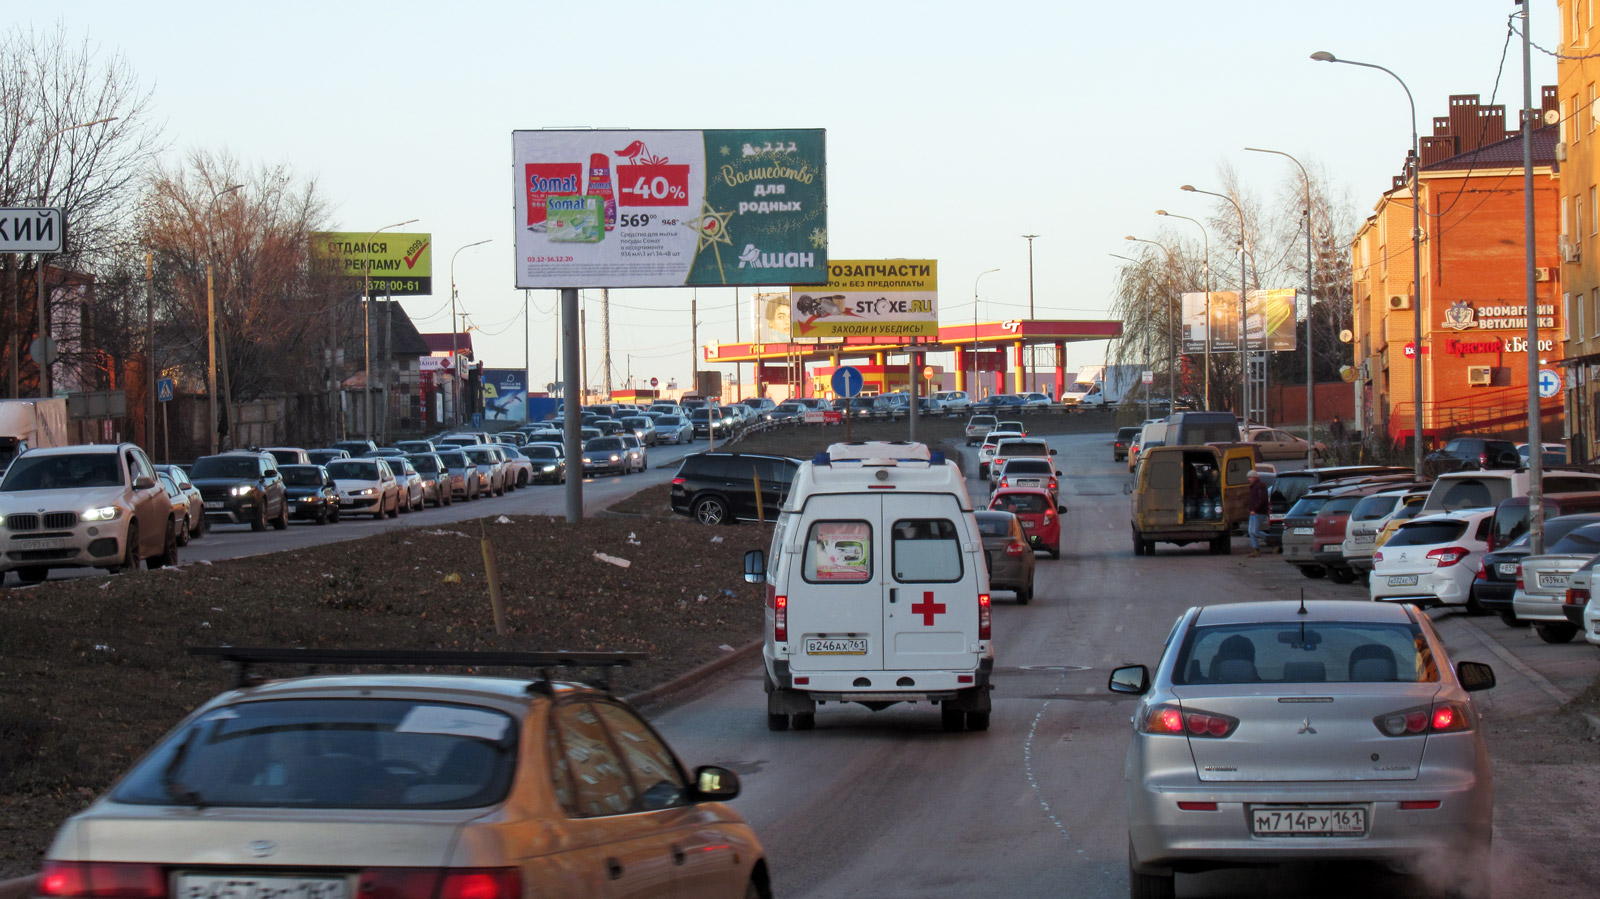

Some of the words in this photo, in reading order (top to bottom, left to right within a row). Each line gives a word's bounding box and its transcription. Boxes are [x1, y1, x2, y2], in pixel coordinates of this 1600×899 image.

[721, 161, 813, 187] Волшебство
[531, 175, 577, 192] Somat
[622, 176, 685, 199] -40%
[754, 184, 785, 197] для
[548, 198, 586, 211] Somat
[739, 201, 801, 215] родных
[620, 214, 650, 227] 569
[328, 242, 387, 255] ОТДАМСЯ
[738, 244, 814, 269] Ашан
[345, 259, 402, 271] РЕКЛАМУ
[850, 280, 865, 288] БЕЗ
[867, 280, 924, 289] ПРЕДОПЛАТЫ
[1478, 305, 1554, 318] зоомагаин
[832, 325, 868, 333] ЗАХОДИ
[870, 325, 877, 333] И
[879, 324, 924, 333] УБЕДИСЬ!
[1002, 320, 1021, 333] GT
[1479, 317, 1554, 330] ветклика
[1445, 338, 1502, 358] Красное
[849, 640, 865, 648] 761
[1258, 812, 1330, 831] М714РУ
[1333, 811, 1360, 825] 161
